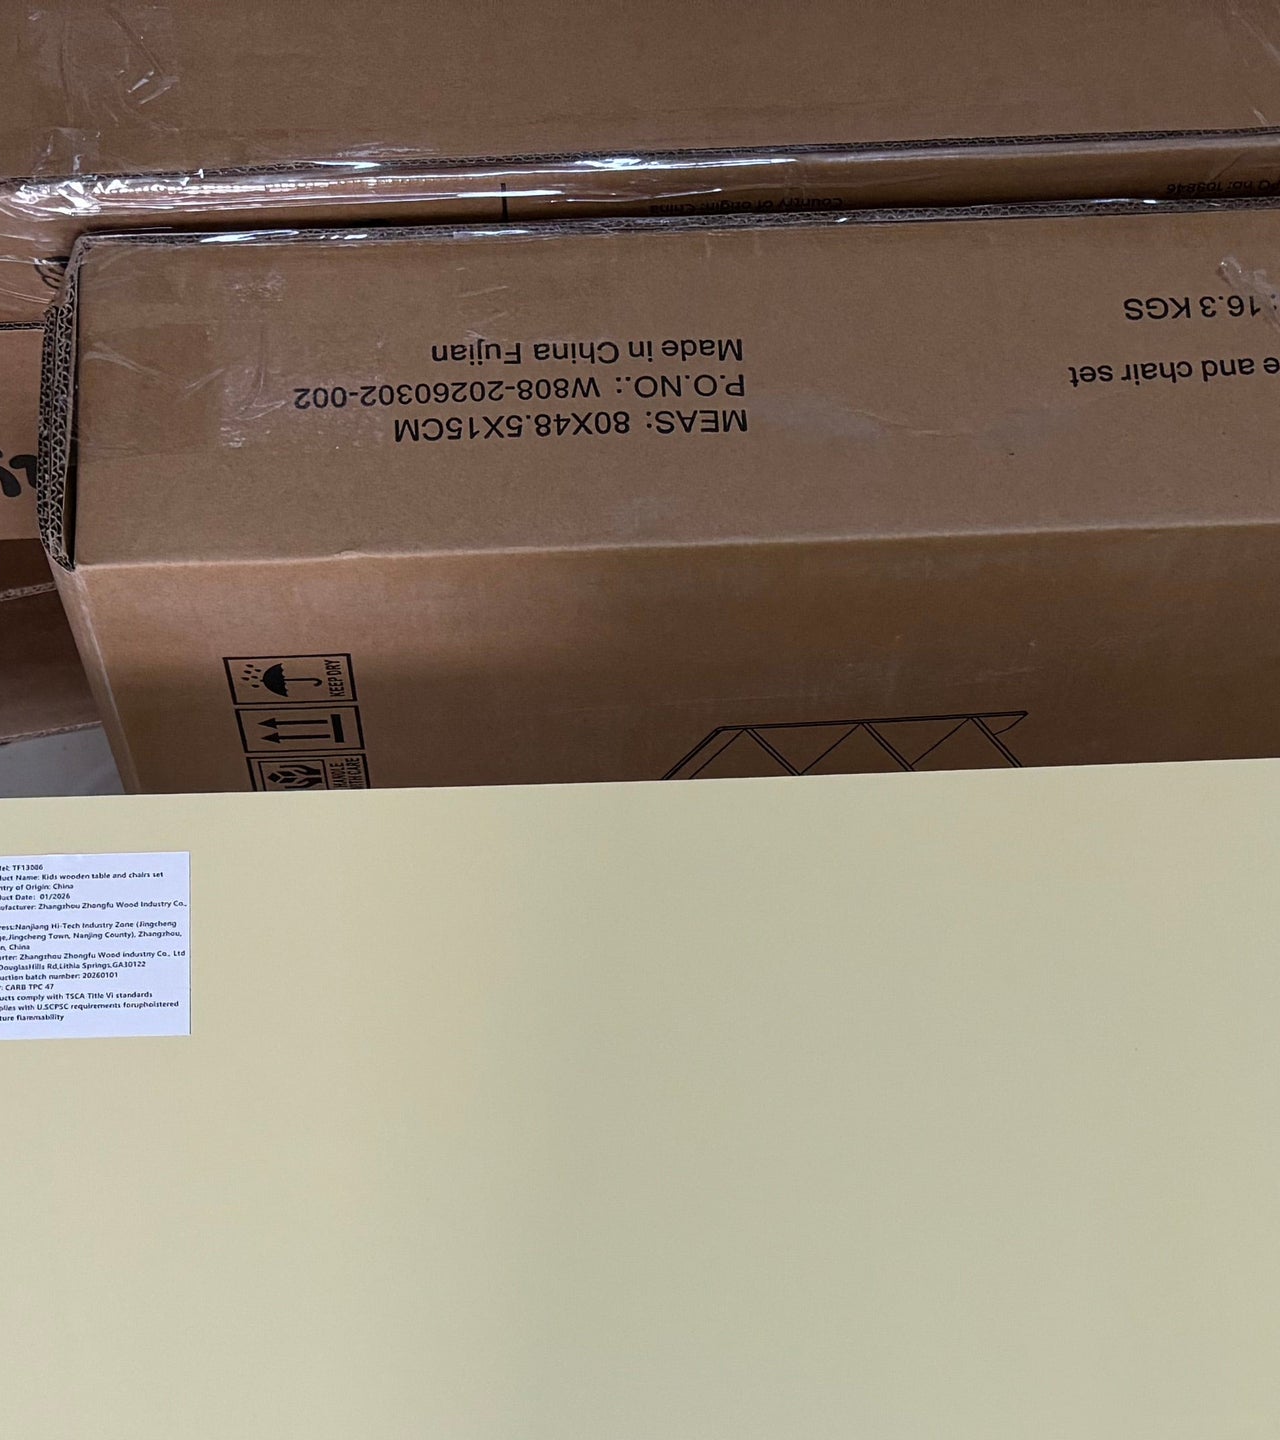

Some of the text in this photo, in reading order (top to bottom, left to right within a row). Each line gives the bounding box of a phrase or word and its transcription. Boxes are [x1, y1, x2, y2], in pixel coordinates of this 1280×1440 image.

[1124, 297, 1192, 321] KGS
[1200, 294, 1261, 317] 16.3
[430, 339, 743, 366] Made in China Fujian
[1068, 364, 1113, 386] set
[1121, 359, 1193, 385] chair
[1202, 358, 1256, 380] and
[294, 374, 746, 409] P.O.NO.: W808-20260302-002
[394, 409, 748, 442] MEAS: 80X48.5X15CM
[324, 659, 345, 697] KEEP DRY
